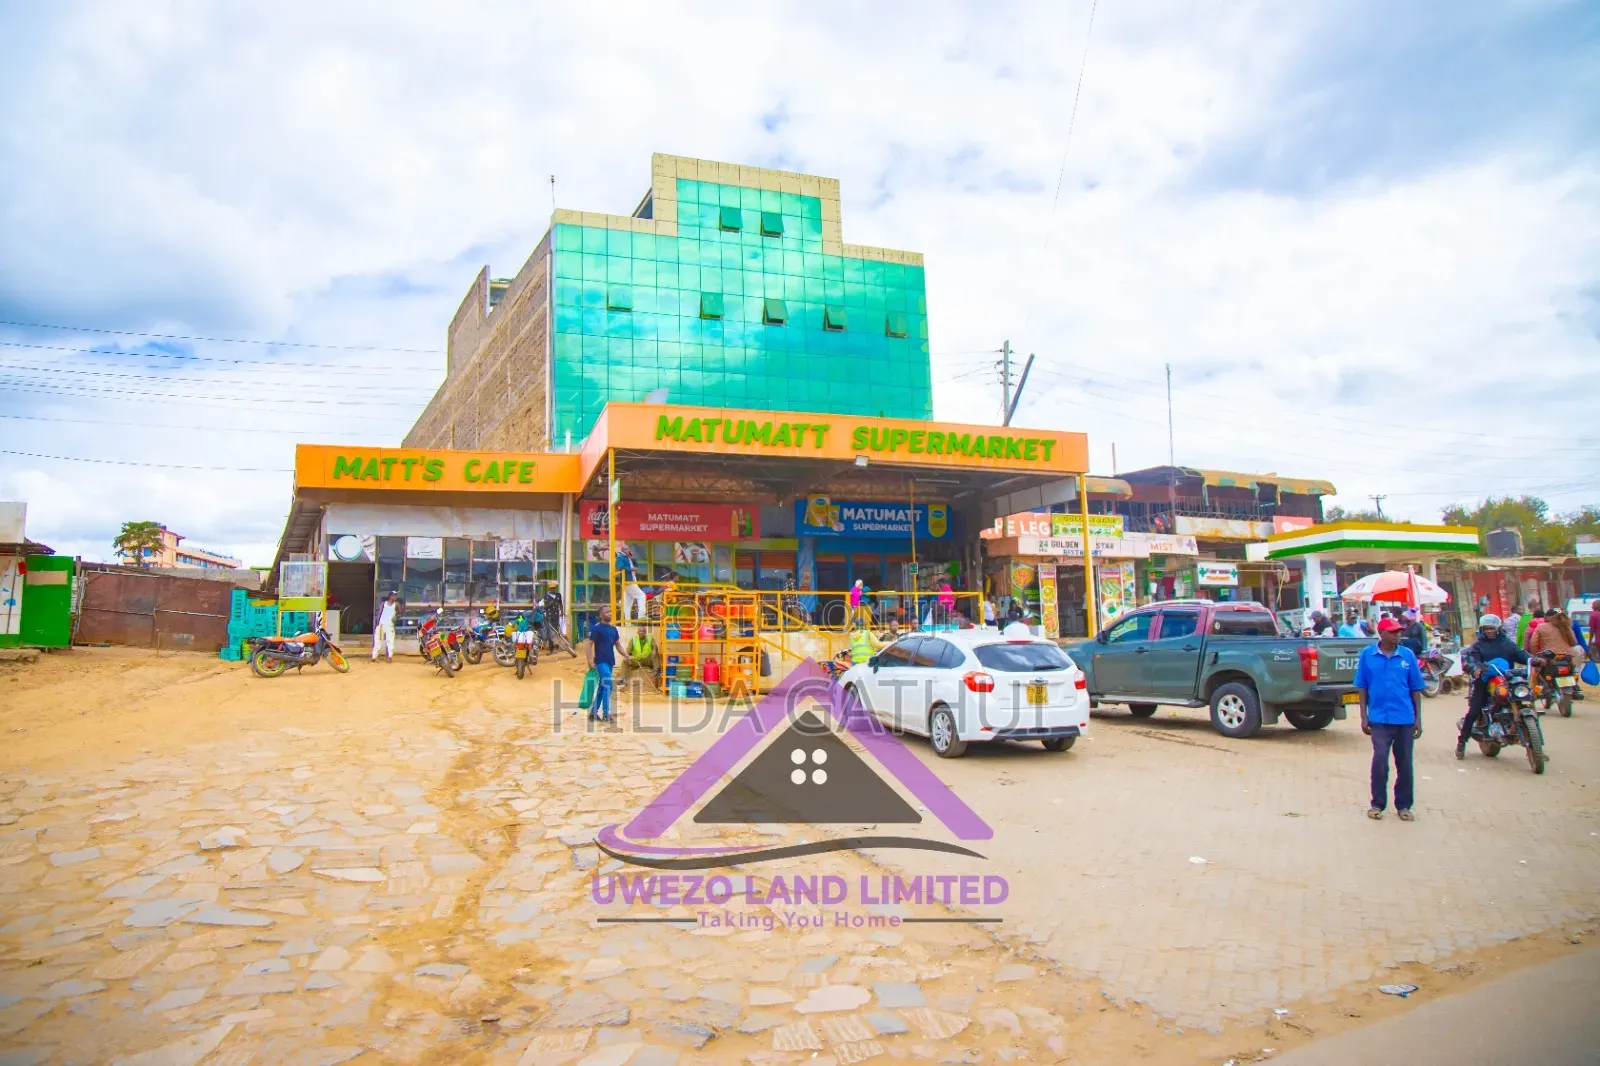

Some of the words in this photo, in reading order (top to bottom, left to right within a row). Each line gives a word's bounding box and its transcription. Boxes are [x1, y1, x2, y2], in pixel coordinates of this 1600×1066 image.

[655, 415, 831, 449] MATUMATT
[852, 426, 1056, 461] SUPERMARKET
[333, 456, 445, 481] MATT'S
[464, 459, 536, 483] CAFE
[648, 513, 700, 522] MATUMATT
[842, 507, 922, 522] MATUMATT
[639, 523, 708, 533] SUPERMARKET
[852, 522, 914, 532] SUPERMARKET
[1051, 541, 1079, 549] GOLDEN
[1335, 658, 1360, 670] ISUZ
